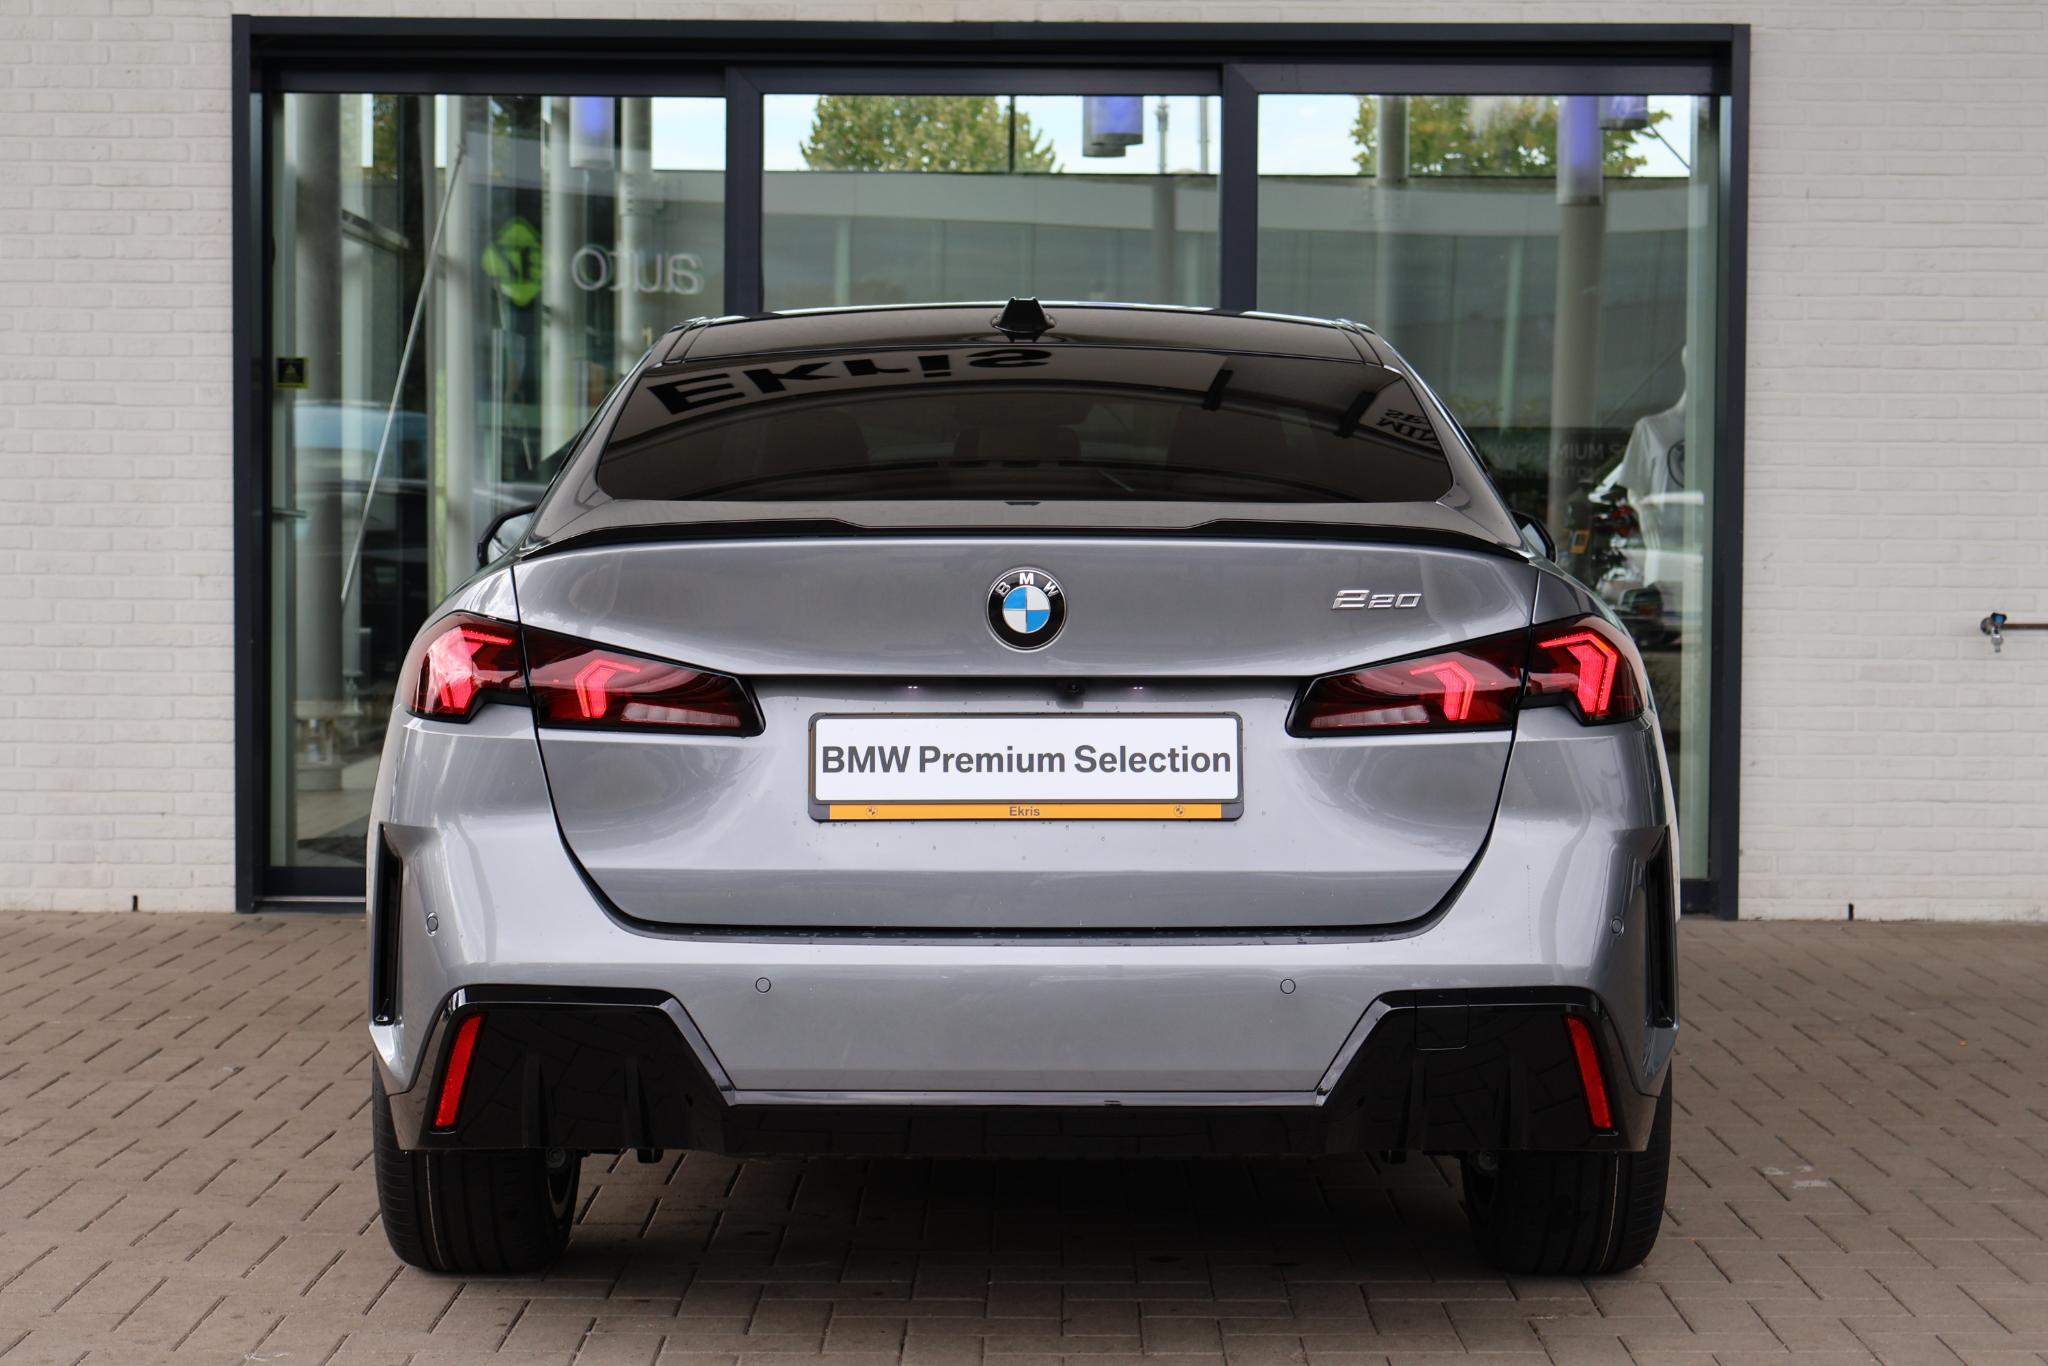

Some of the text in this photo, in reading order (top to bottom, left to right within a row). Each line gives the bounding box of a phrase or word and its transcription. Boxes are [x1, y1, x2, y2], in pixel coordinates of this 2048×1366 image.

[994, 572, 1060, 598] BMW
[1331, 589, 1422, 609] 220
[821, 744, 1232, 774] BMW Premium Selection
[1008, 806, 1041, 818] Ekris
